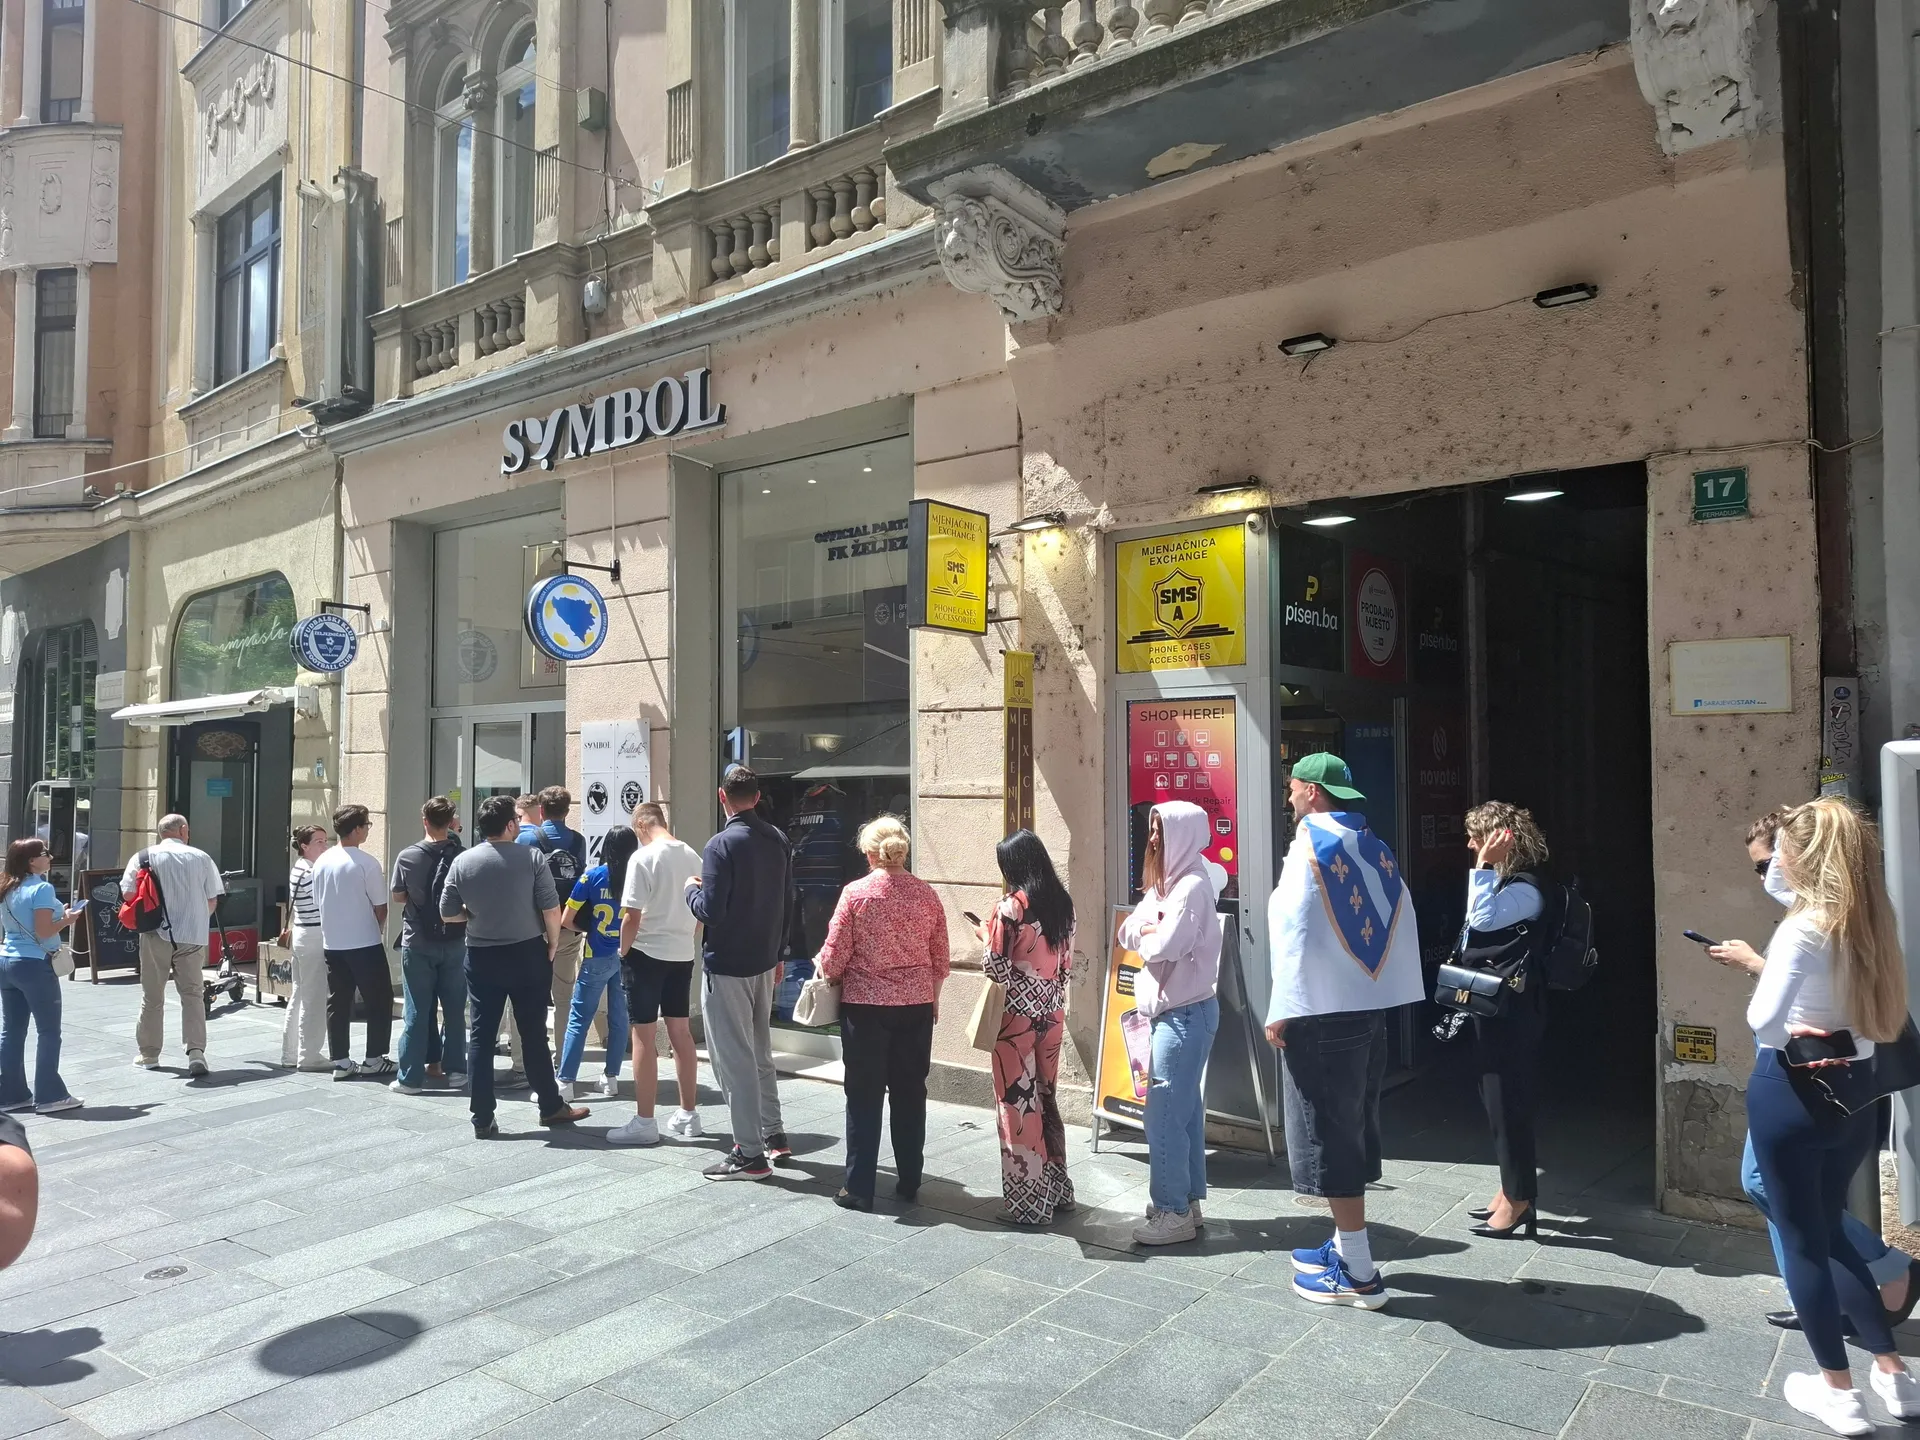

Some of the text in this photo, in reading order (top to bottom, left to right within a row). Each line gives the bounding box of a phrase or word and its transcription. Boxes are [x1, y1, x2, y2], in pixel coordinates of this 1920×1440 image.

[501, 367, 726, 475] SYMBOL
[1702, 476, 1736, 499] 17
[931, 513, 984, 533] MJENJAČNICA
[938, 526, 976, 542] EXCHANGE
[828, 545, 849, 561] FK
[1141, 537, 1216, 557] MJENJAČNICA
[1149, 549, 1208, 566] EXCHANGE
[947, 560, 965, 574] SMS
[952, 574, 958, 585] A
[1160, 586, 1197, 605] SMS
[933, 603, 977, 617] PHONE CASES
[1172, 605, 1184, 621] A
[1285, 601, 1338, 631] pisen.ba
[1361, 601, 1394, 619] PRODAJNO
[934, 612, 977, 625] ACCESSORIES
[1365, 616, 1390, 631] MJESTO
[303, 615, 355, 641] FUDBALSKI KLUB
[1148, 642, 1211, 655] PHONE CASES
[305, 650, 353, 670] FOOTBALL CLUB
[1149, 652, 1211, 665] ACCESSORIES
[1703, 699, 1756, 707] SARAJEVOSTAN
[1140, 707, 1225, 722] SHOP HERE!
[1420, 766, 1461, 787] novotel
[1203, 797, 1232, 806] Repair
